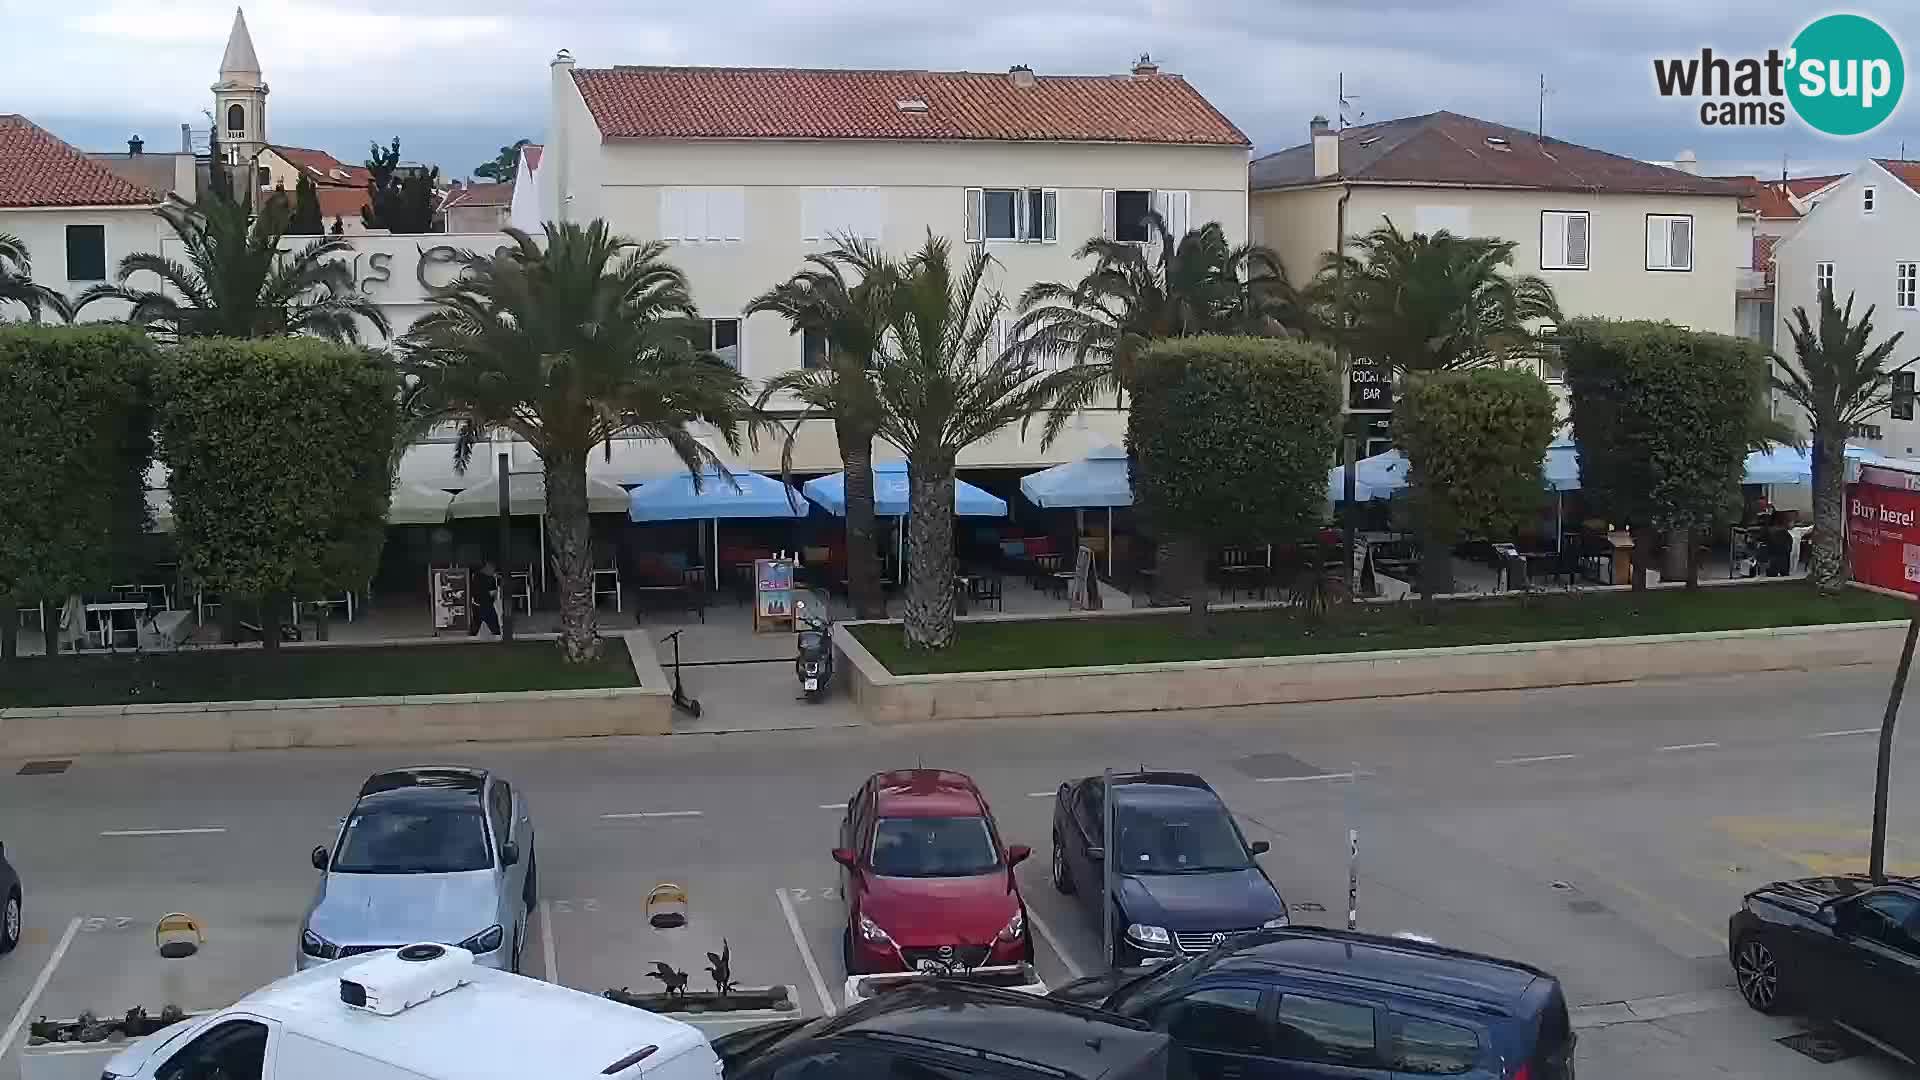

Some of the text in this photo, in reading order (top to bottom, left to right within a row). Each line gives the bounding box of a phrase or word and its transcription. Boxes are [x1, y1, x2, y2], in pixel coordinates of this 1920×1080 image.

[1363, 388, 1381, 400] BAR
[1852, 499, 1914, 526] Buy here!
